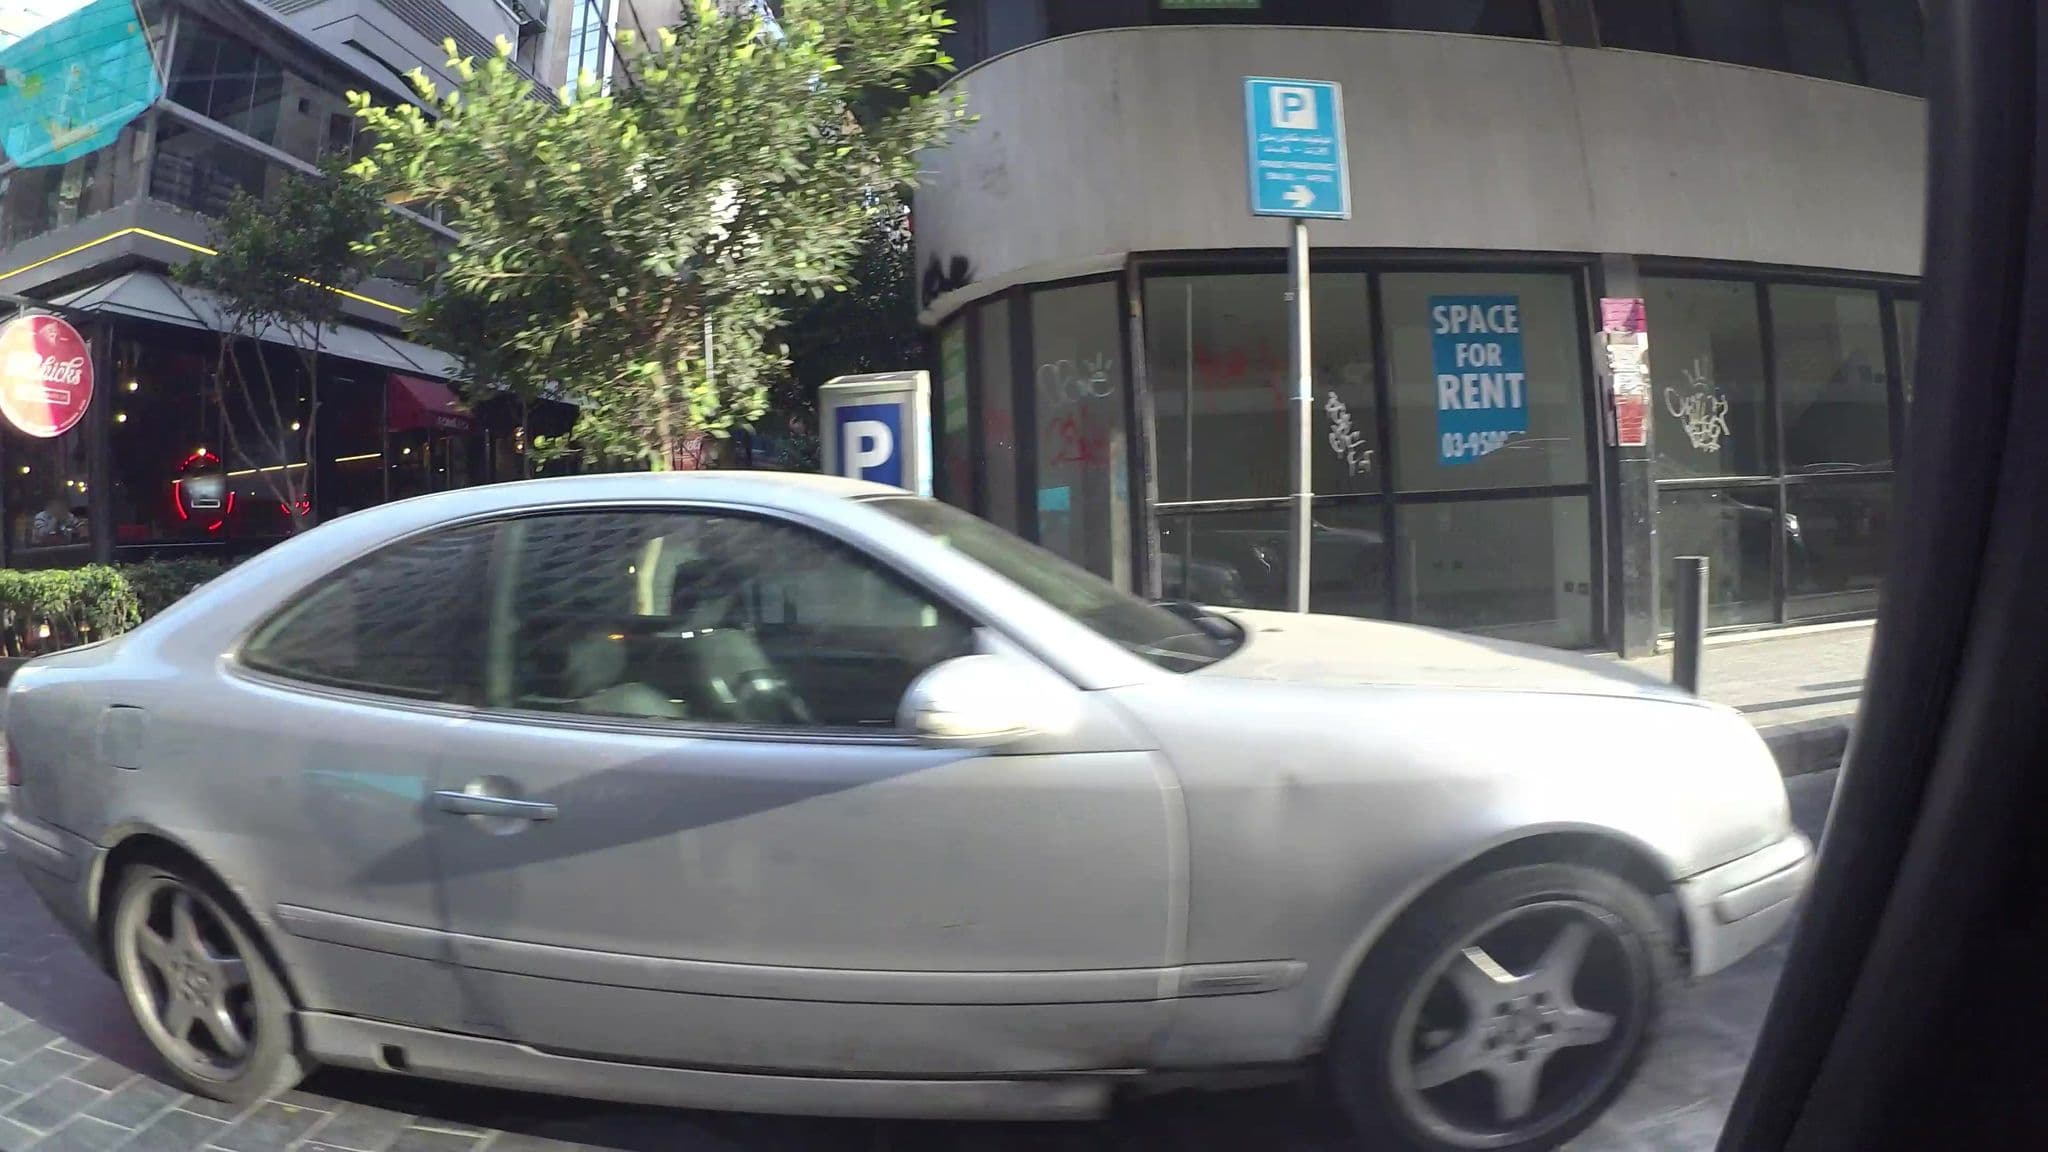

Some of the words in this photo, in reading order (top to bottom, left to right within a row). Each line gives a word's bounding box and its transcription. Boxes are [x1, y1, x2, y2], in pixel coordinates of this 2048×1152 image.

[1279, 92, 1306, 122] P
[1432, 304, 1519, 335] SPACE
[1455, 343, 1502, 367] FOR
[1437, 373, 1525, 411] RENT
[843, 420, 894, 481] P
